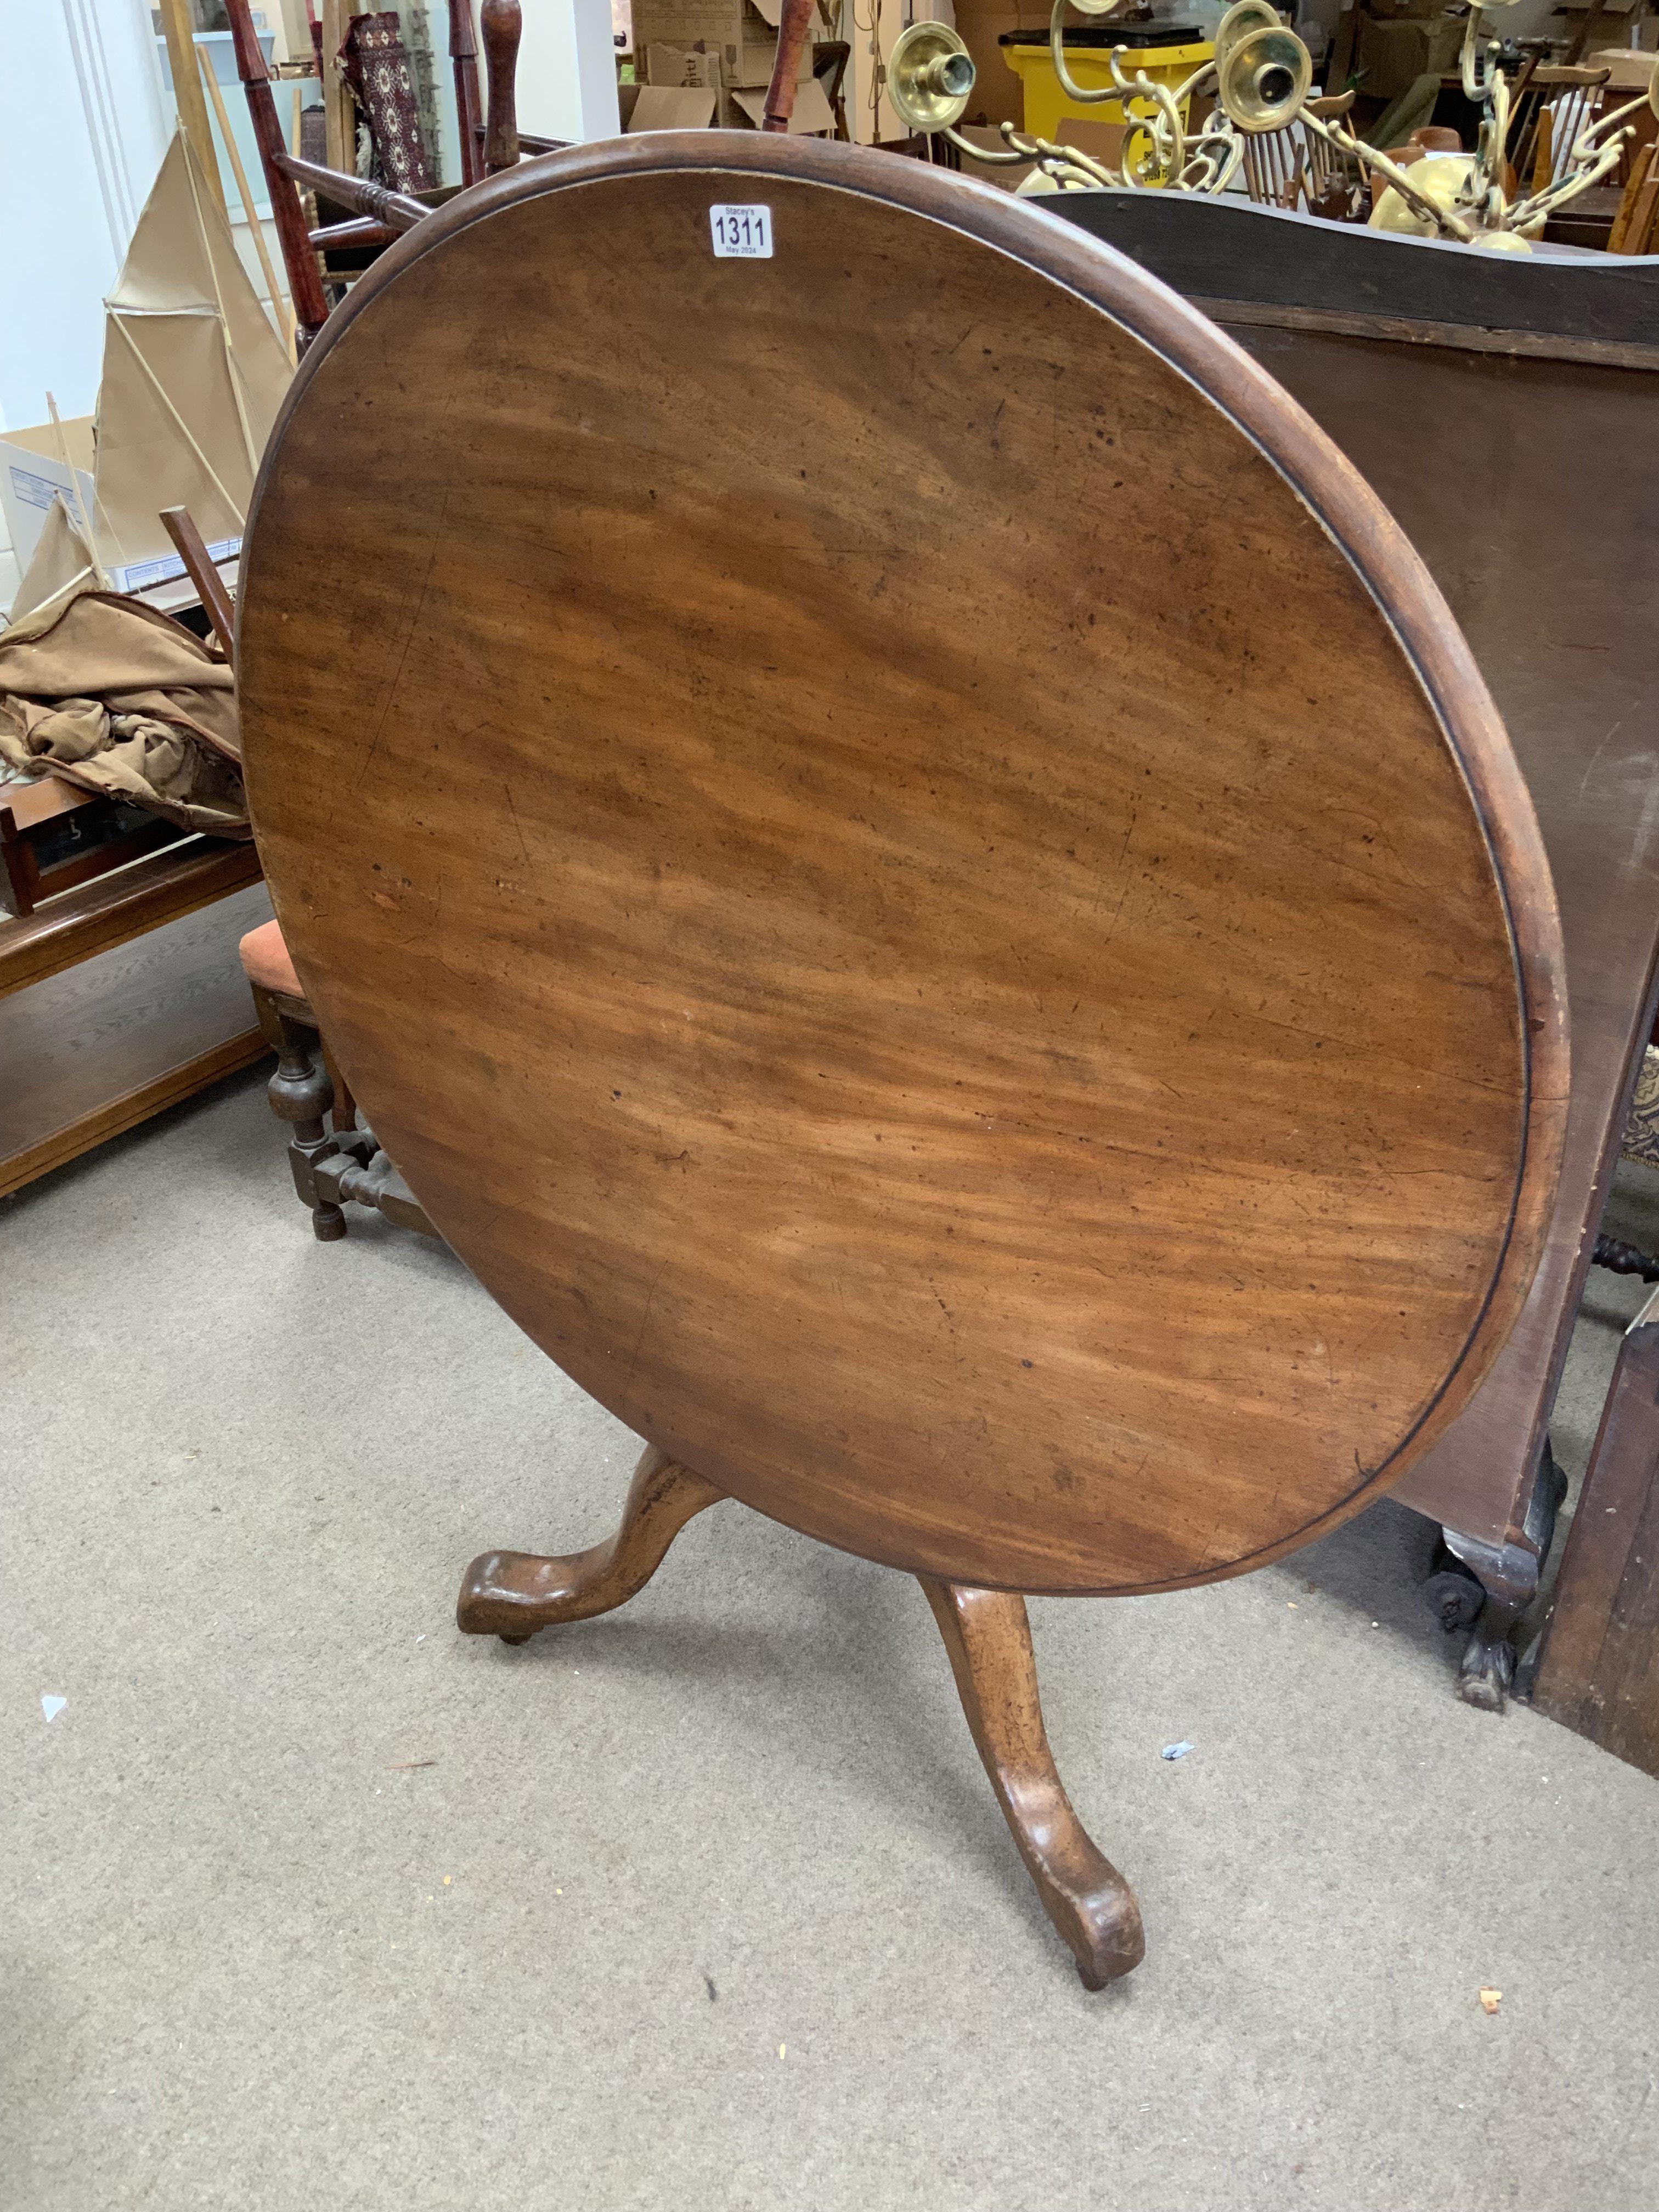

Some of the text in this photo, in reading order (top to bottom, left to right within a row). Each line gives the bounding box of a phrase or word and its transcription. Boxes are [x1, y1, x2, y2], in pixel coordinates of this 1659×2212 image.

[725, 207, 755, 217] Stacey's
[716, 216, 764, 246] 1311
[726, 246, 739, 255] May
[128, 565, 159, 578] CONTENTS
